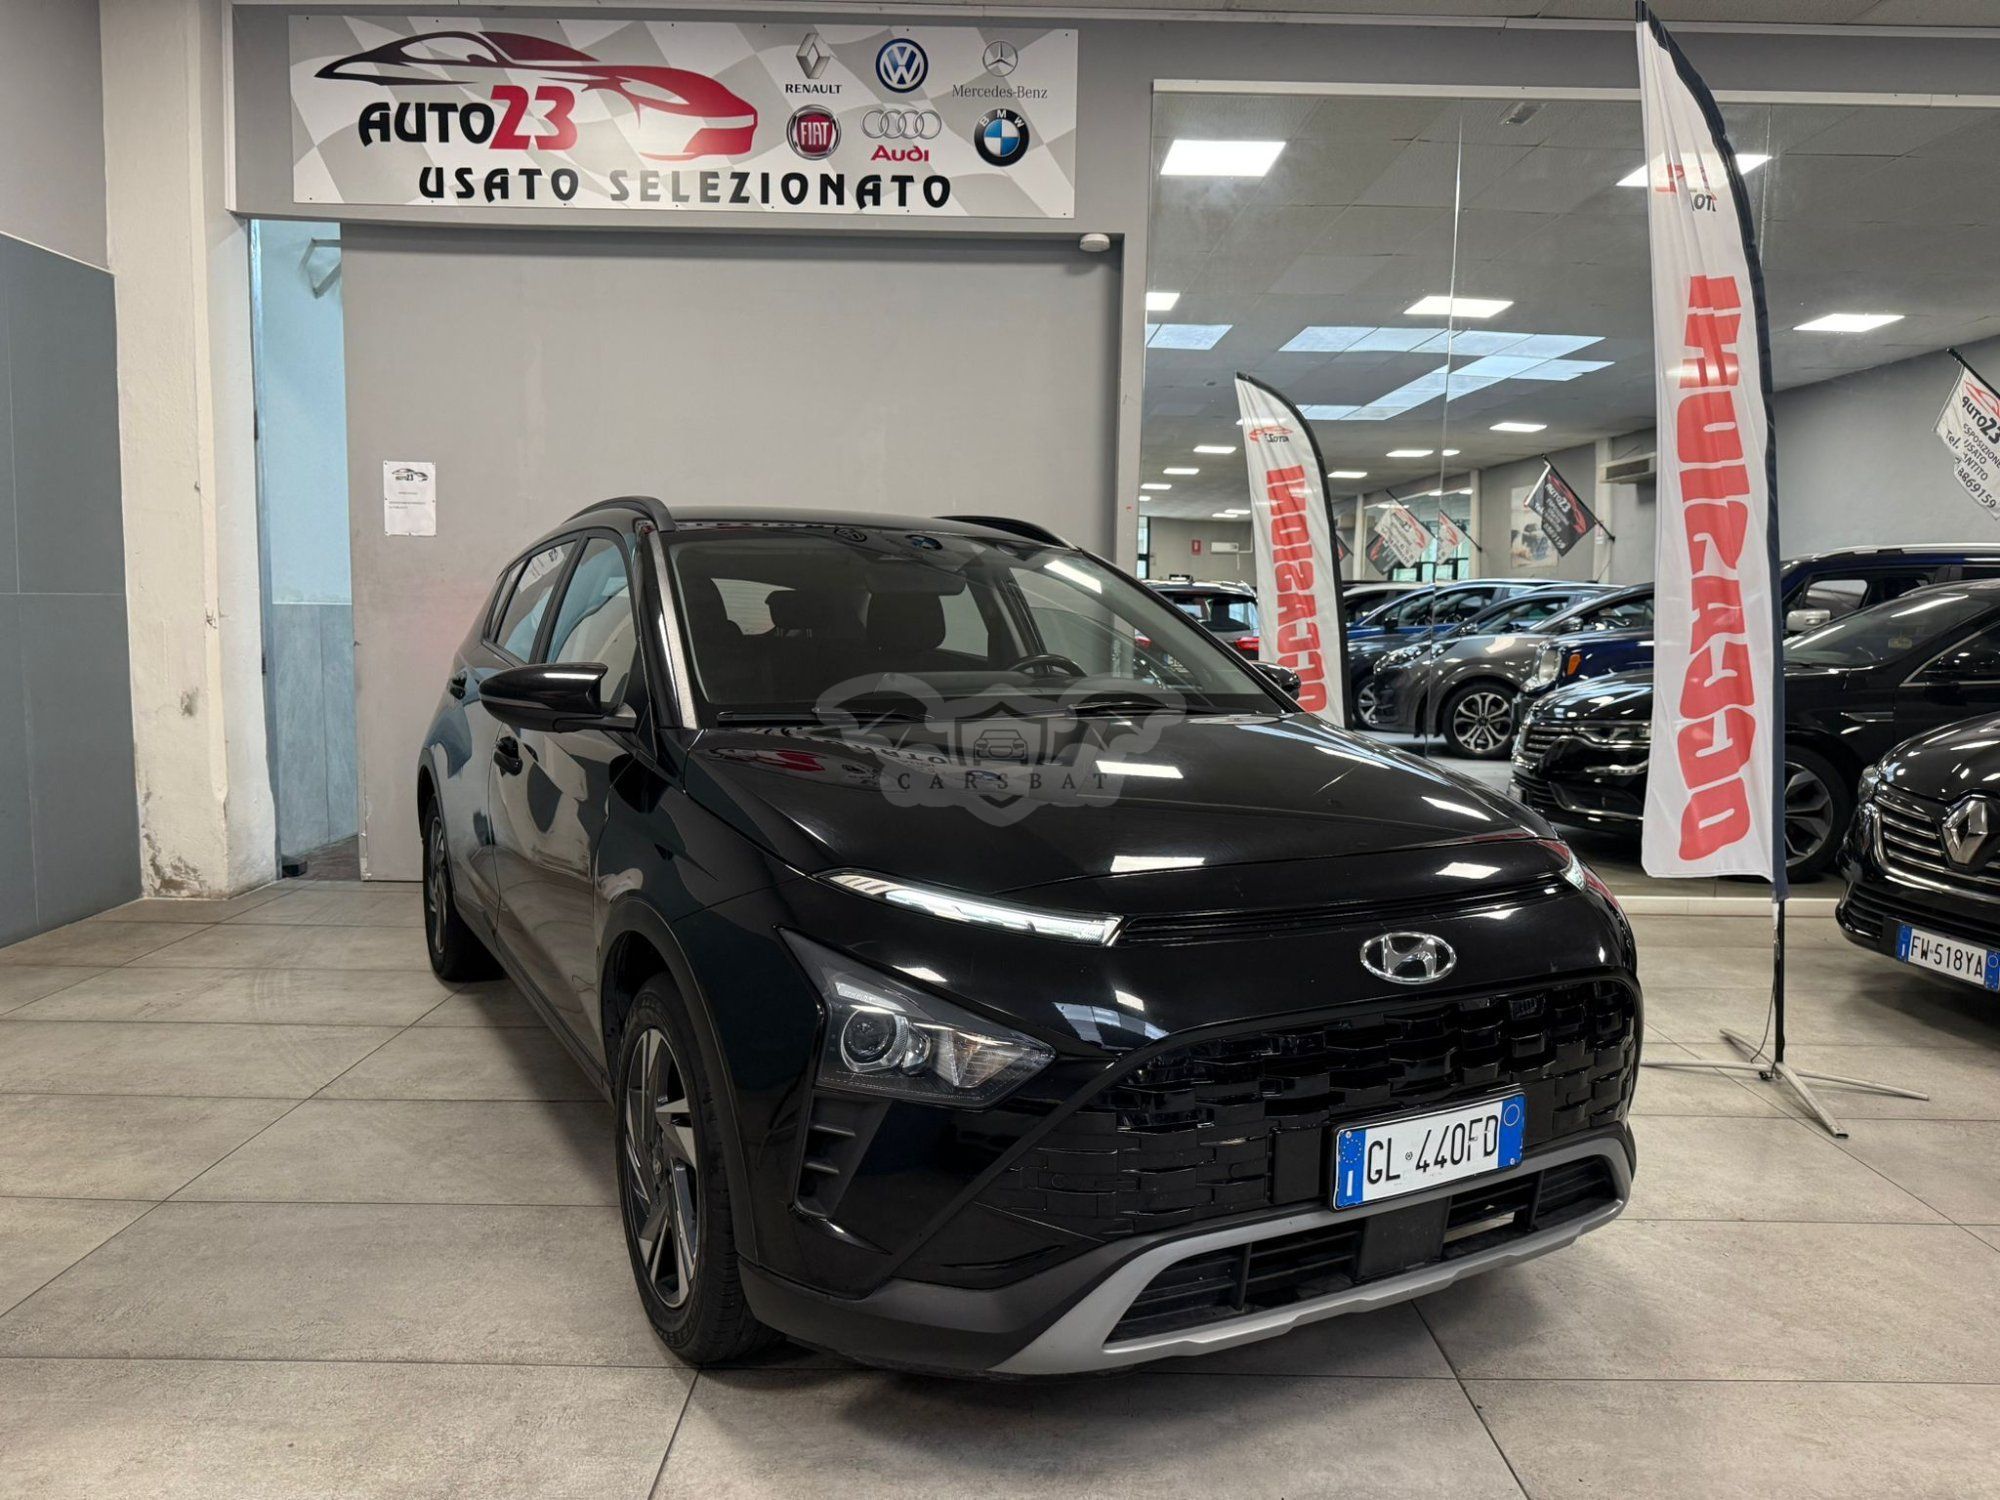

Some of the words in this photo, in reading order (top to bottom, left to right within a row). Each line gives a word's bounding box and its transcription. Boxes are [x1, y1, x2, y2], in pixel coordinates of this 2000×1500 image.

[785, 83, 842, 94] RENAULT
[952, 85, 1048, 99] Mercedes-Benz
[358, 84, 578, 150] AUTO23
[800, 122, 829, 145] FIAT
[871, 145, 929, 161] Audi
[419, 167, 579, 203] USATO
[609, 170, 951, 210] SELEZIONATO
